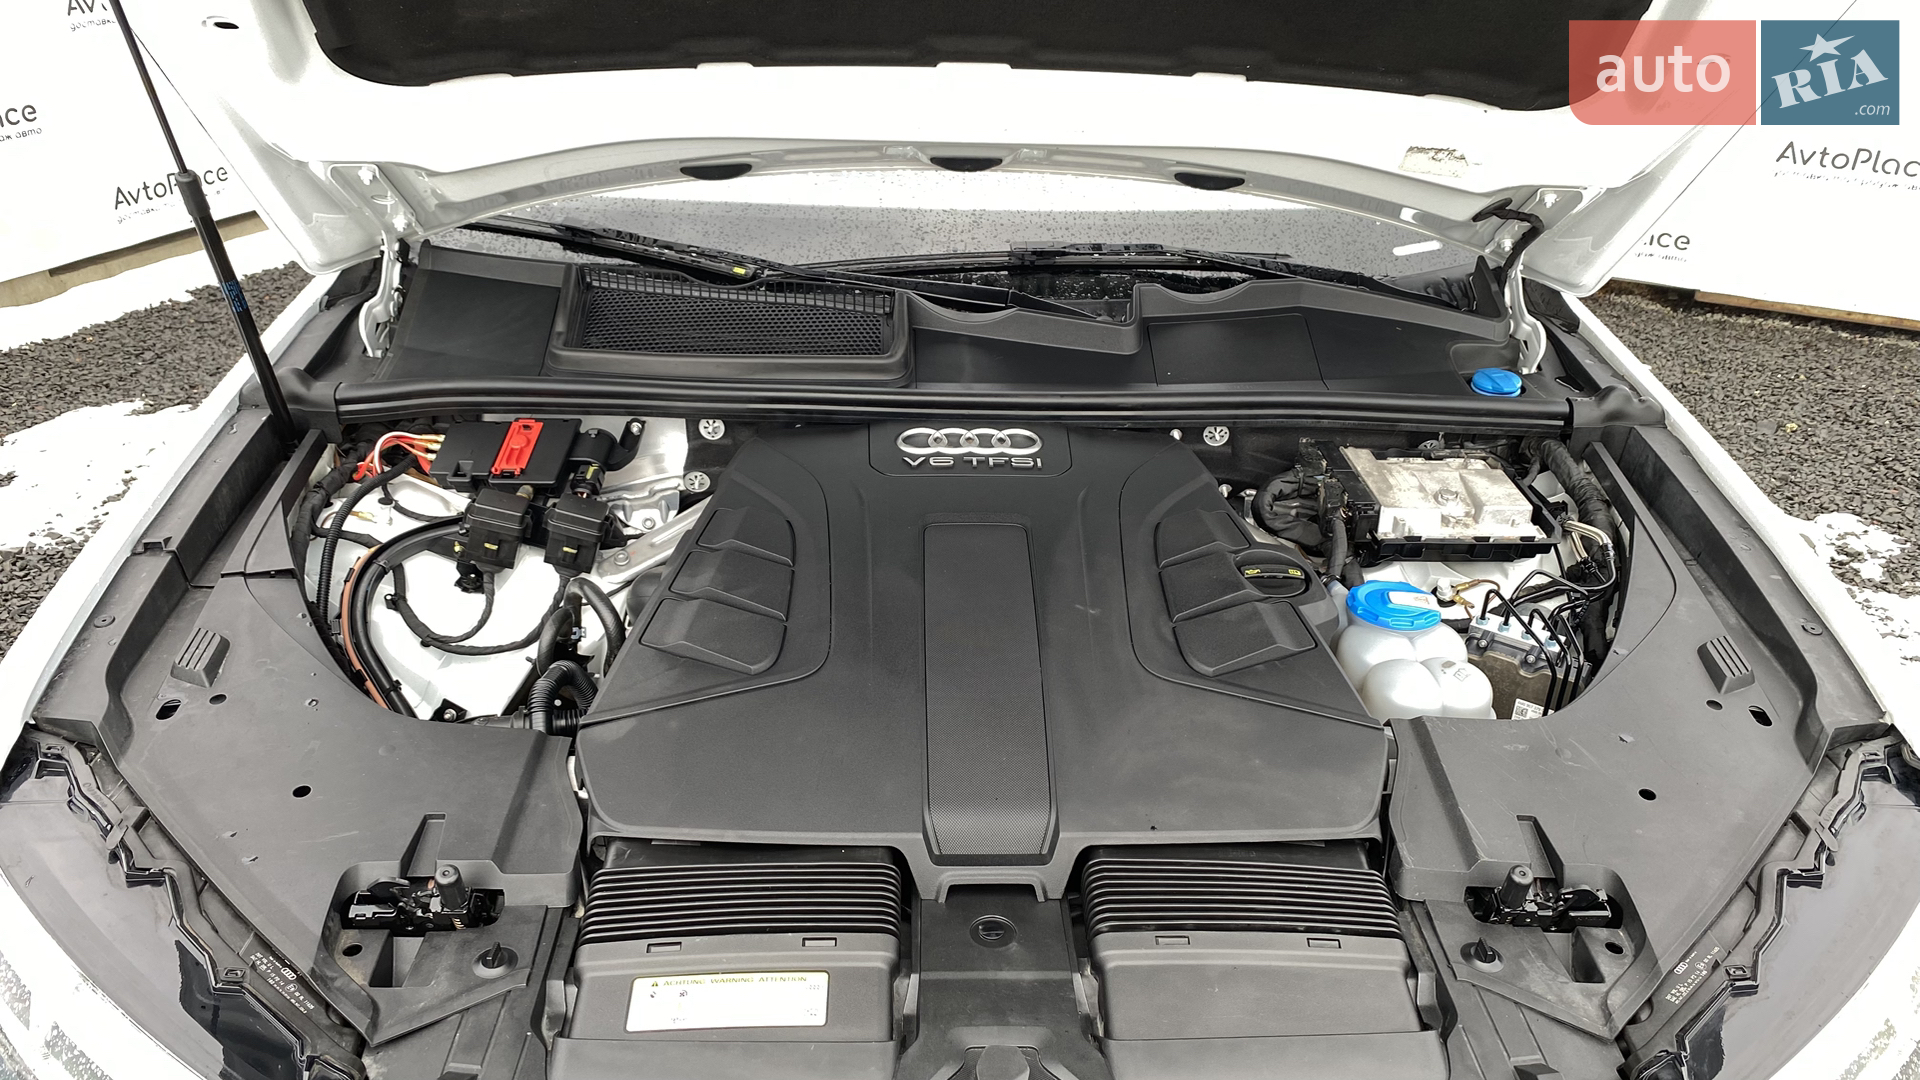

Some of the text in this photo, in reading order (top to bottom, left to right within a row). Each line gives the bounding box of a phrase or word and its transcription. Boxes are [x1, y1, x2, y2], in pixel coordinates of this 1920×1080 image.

[0, 104, 37, 128] ce
[1775, 140, 1920, 177] AvtoPlac
[114, 166, 228, 210] AvtoPce
[902, 456, 1043, 469] V6 TFSI
[663, 978, 706, 987] ACHTUNG
